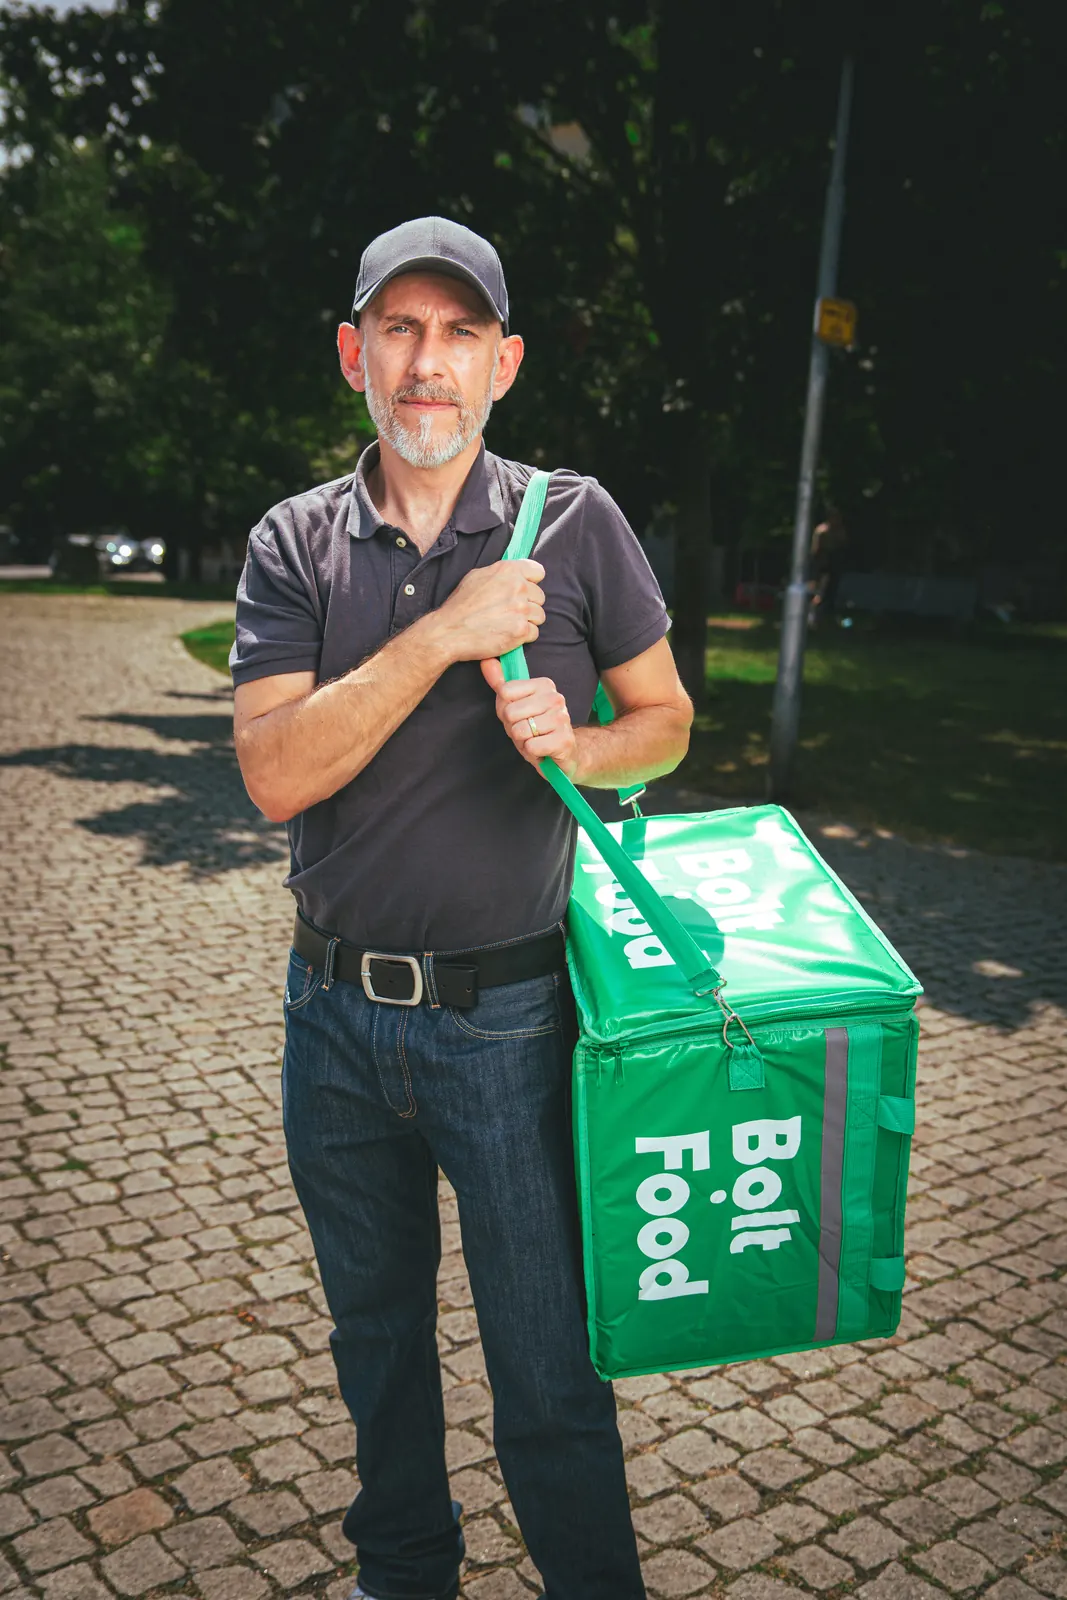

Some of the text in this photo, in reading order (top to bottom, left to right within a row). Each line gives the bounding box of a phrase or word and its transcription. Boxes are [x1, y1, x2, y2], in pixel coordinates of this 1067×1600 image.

[675, 848, 785, 933] Bolt
[635, 1130, 710, 1301] Food
[729, 1115, 802, 1254] Bolt
